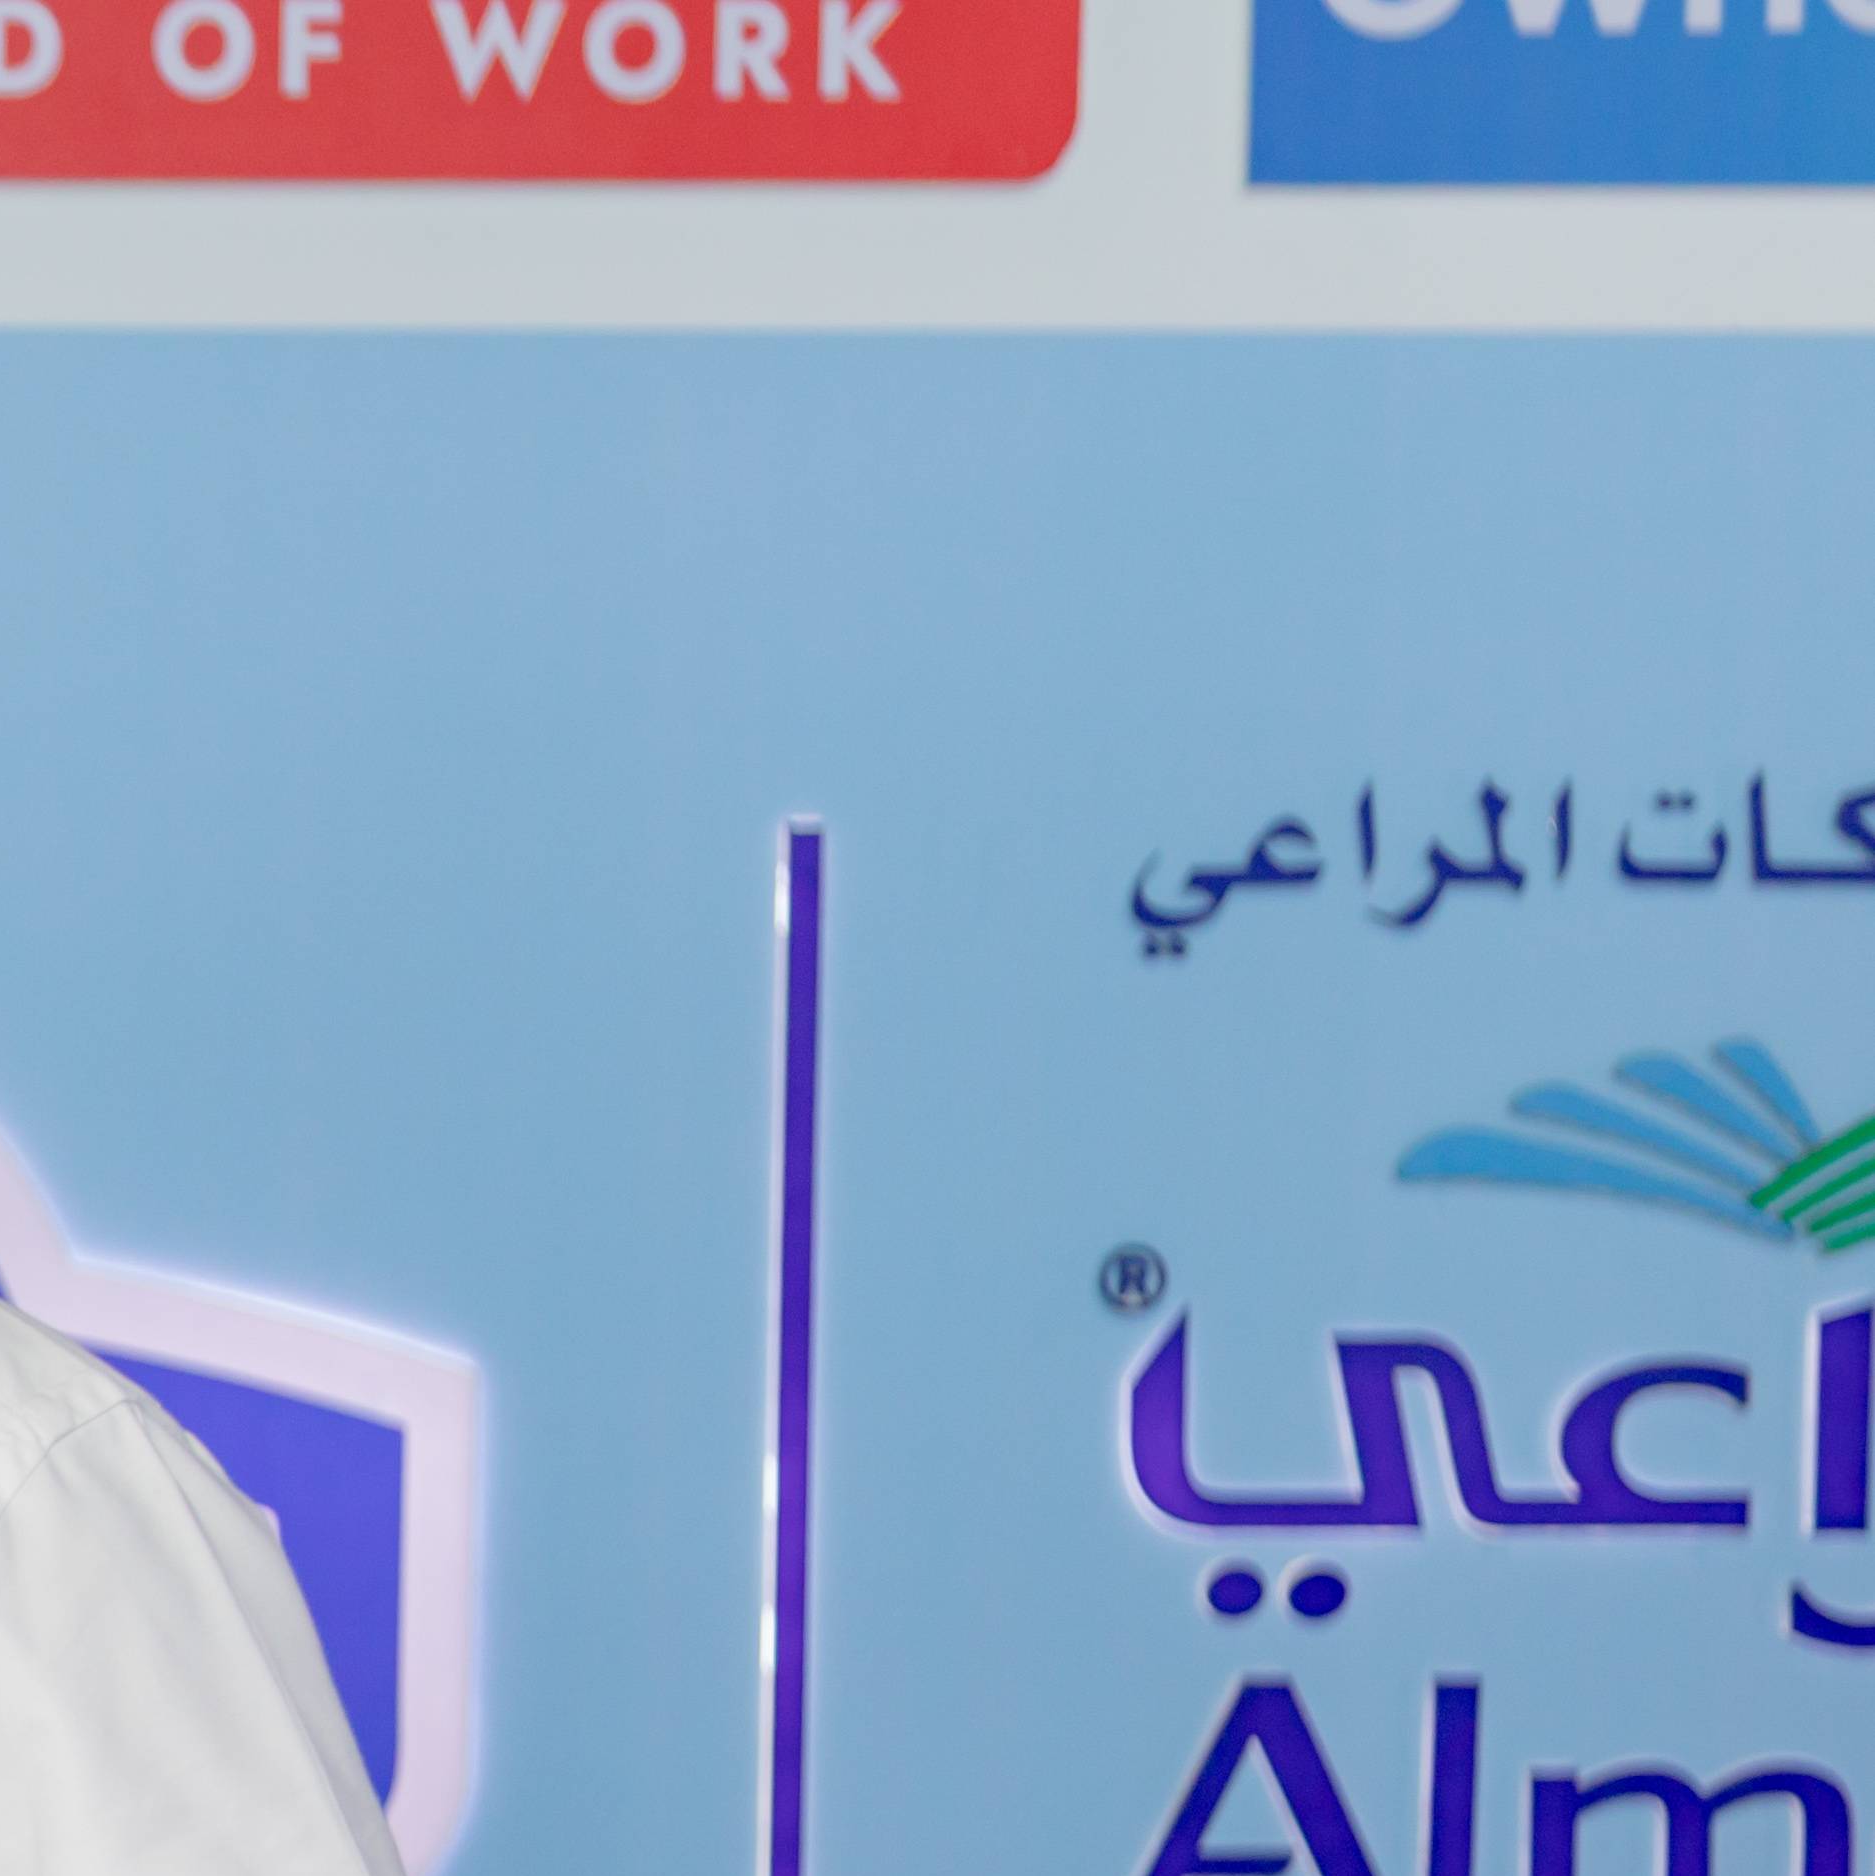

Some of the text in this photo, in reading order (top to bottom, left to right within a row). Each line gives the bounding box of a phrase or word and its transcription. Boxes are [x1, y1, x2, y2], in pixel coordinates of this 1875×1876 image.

[151, 0, 345, 97] OF
[431, 0, 901, 100] WORK
[1129, 775, 1575, 958] المراعي
